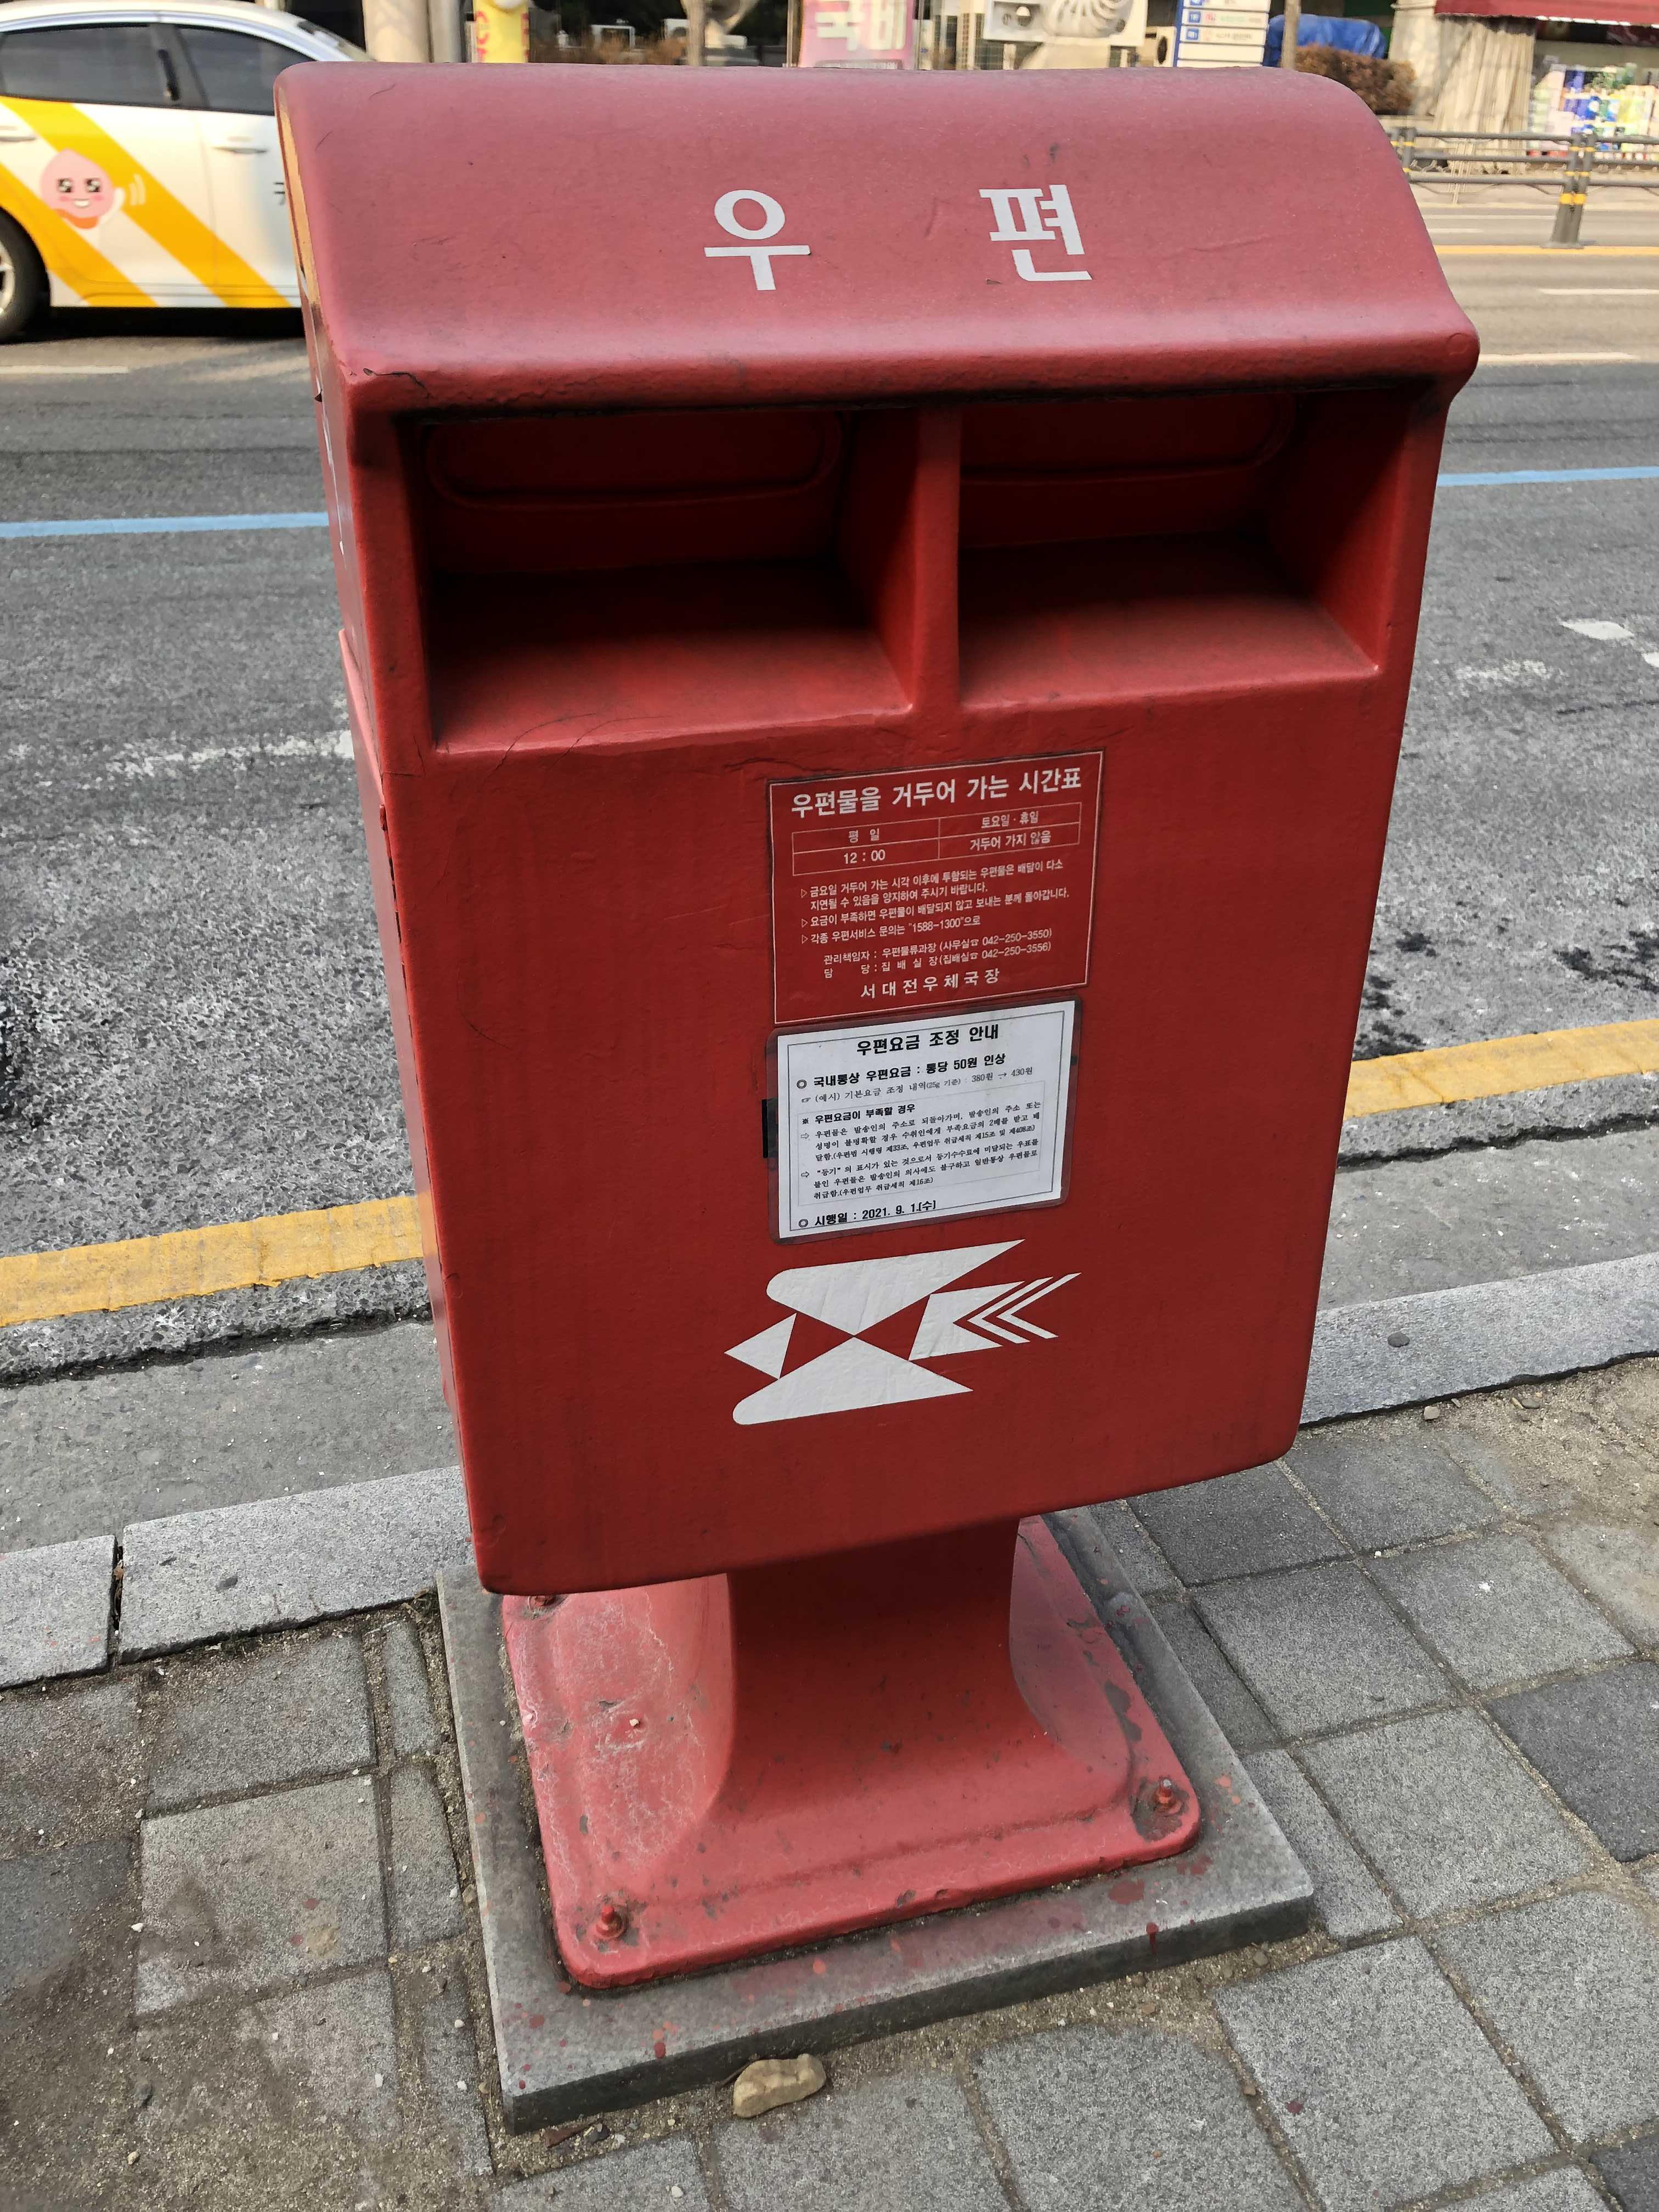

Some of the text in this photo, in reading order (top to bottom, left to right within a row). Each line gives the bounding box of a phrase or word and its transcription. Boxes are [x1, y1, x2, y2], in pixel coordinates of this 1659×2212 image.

[791, 767, 1081, 819] 우편물을 거두어 가는 시간표
[981, 814, 1010, 828] 토요일
[1019, 810, 1039, 825] 휴일
[969, 830, 1052, 851] 거두어 가지 않음
[810, 884, 837, 898] 금요일
[840, 881, 867, 894] 거두어
[871, 879, 889, 890] 가는
[891, 876, 910, 888] 시각
[912, 873, 939, 886] 이후에
[980, 864, 1014, 878] 우편물은
[1017, 861, 1043, 873] 배달이
[1046, 859, 1063, 870] 다소
[810, 882, 988, 911] 지연될 수 있음을 양지하여 주시기 바랍니다.
[810, 887, 1069, 927] 요금이 부족하면 우편물이 배달되지 않고 보내는 분께 돌아갑니다.
[810, 932, 828, 944] 각종
[831, 928, 876, 942] 우편서비스
[879, 924, 905, 937] 문의는
[823, 950, 870, 965] 관리책임자
[882, 942, 936, 958] 우편물류과장
[856, 1024, 998, 1056] 우편요금 조정 안내
[814, 1072, 860, 1087] 국내통상
[866, 1066, 911, 1082] 우편요금
[926, 1061, 949, 1074] 통당
[953, 1057, 978, 1070] 50원
[984, 1053, 1006, 1066] 인상
[815, 1092, 840, 1103] (예시)
[844, 1087, 882, 1099] 기본요금
[886, 1084, 903, 1094] 조정
[972, 1072, 993, 1082] 380원
[1011, 1066, 1032, 1077] 430원
[815, 1104, 915, 1124] 우편요금이 부족할 경우
[815, 1127, 848, 1139] 우편물은
[854, 1122, 885, 1134] 발송인의
[891, 1119, 916, 1130] 주소로
[969, 1107, 999, 1118] 발송인의
[1005, 1104, 1020, 1113] 주소
[1025, 1101, 1041, 1109] 또는
[815, 1140, 839, 1150] 성명이
[882, 1133, 898, 1142] 경우
[902, 1127, 941, 1139] 수취인에게
[946, 1120, 984, 1133] 부족요금의
[1013, 1115, 1029, 1123] 받고
[912, 1138, 941, 1149] 우편업무
[975, 1131, 996, 1139] 제15조
[999, 1128, 1006, 1137] 및
[833, 1175, 866, 1186] 우편물은
[870, 1170, 900, 1181] 발송인의
[905, 1166, 936, 1176] 의사에도
[974, 1154, 1005, 1166] 일반통상
[1008, 1149, 1038, 1161] 우편물로
[856, 1161, 879, 1171] 표시가
[883, 1160, 898, 1169] 있는
[902, 1154, 932, 1166] 것으로서
[936, 1147, 980, 1161] 등기수수료에
[984, 1143, 1013, 1153] 미달되는
[1017, 1138, 1039, 1148] 우표를
[814, 1212, 848, 1227] 시행일
[862, 1207, 890, 1220] 2021.
[895, 1205, 905, 1215] 9.
